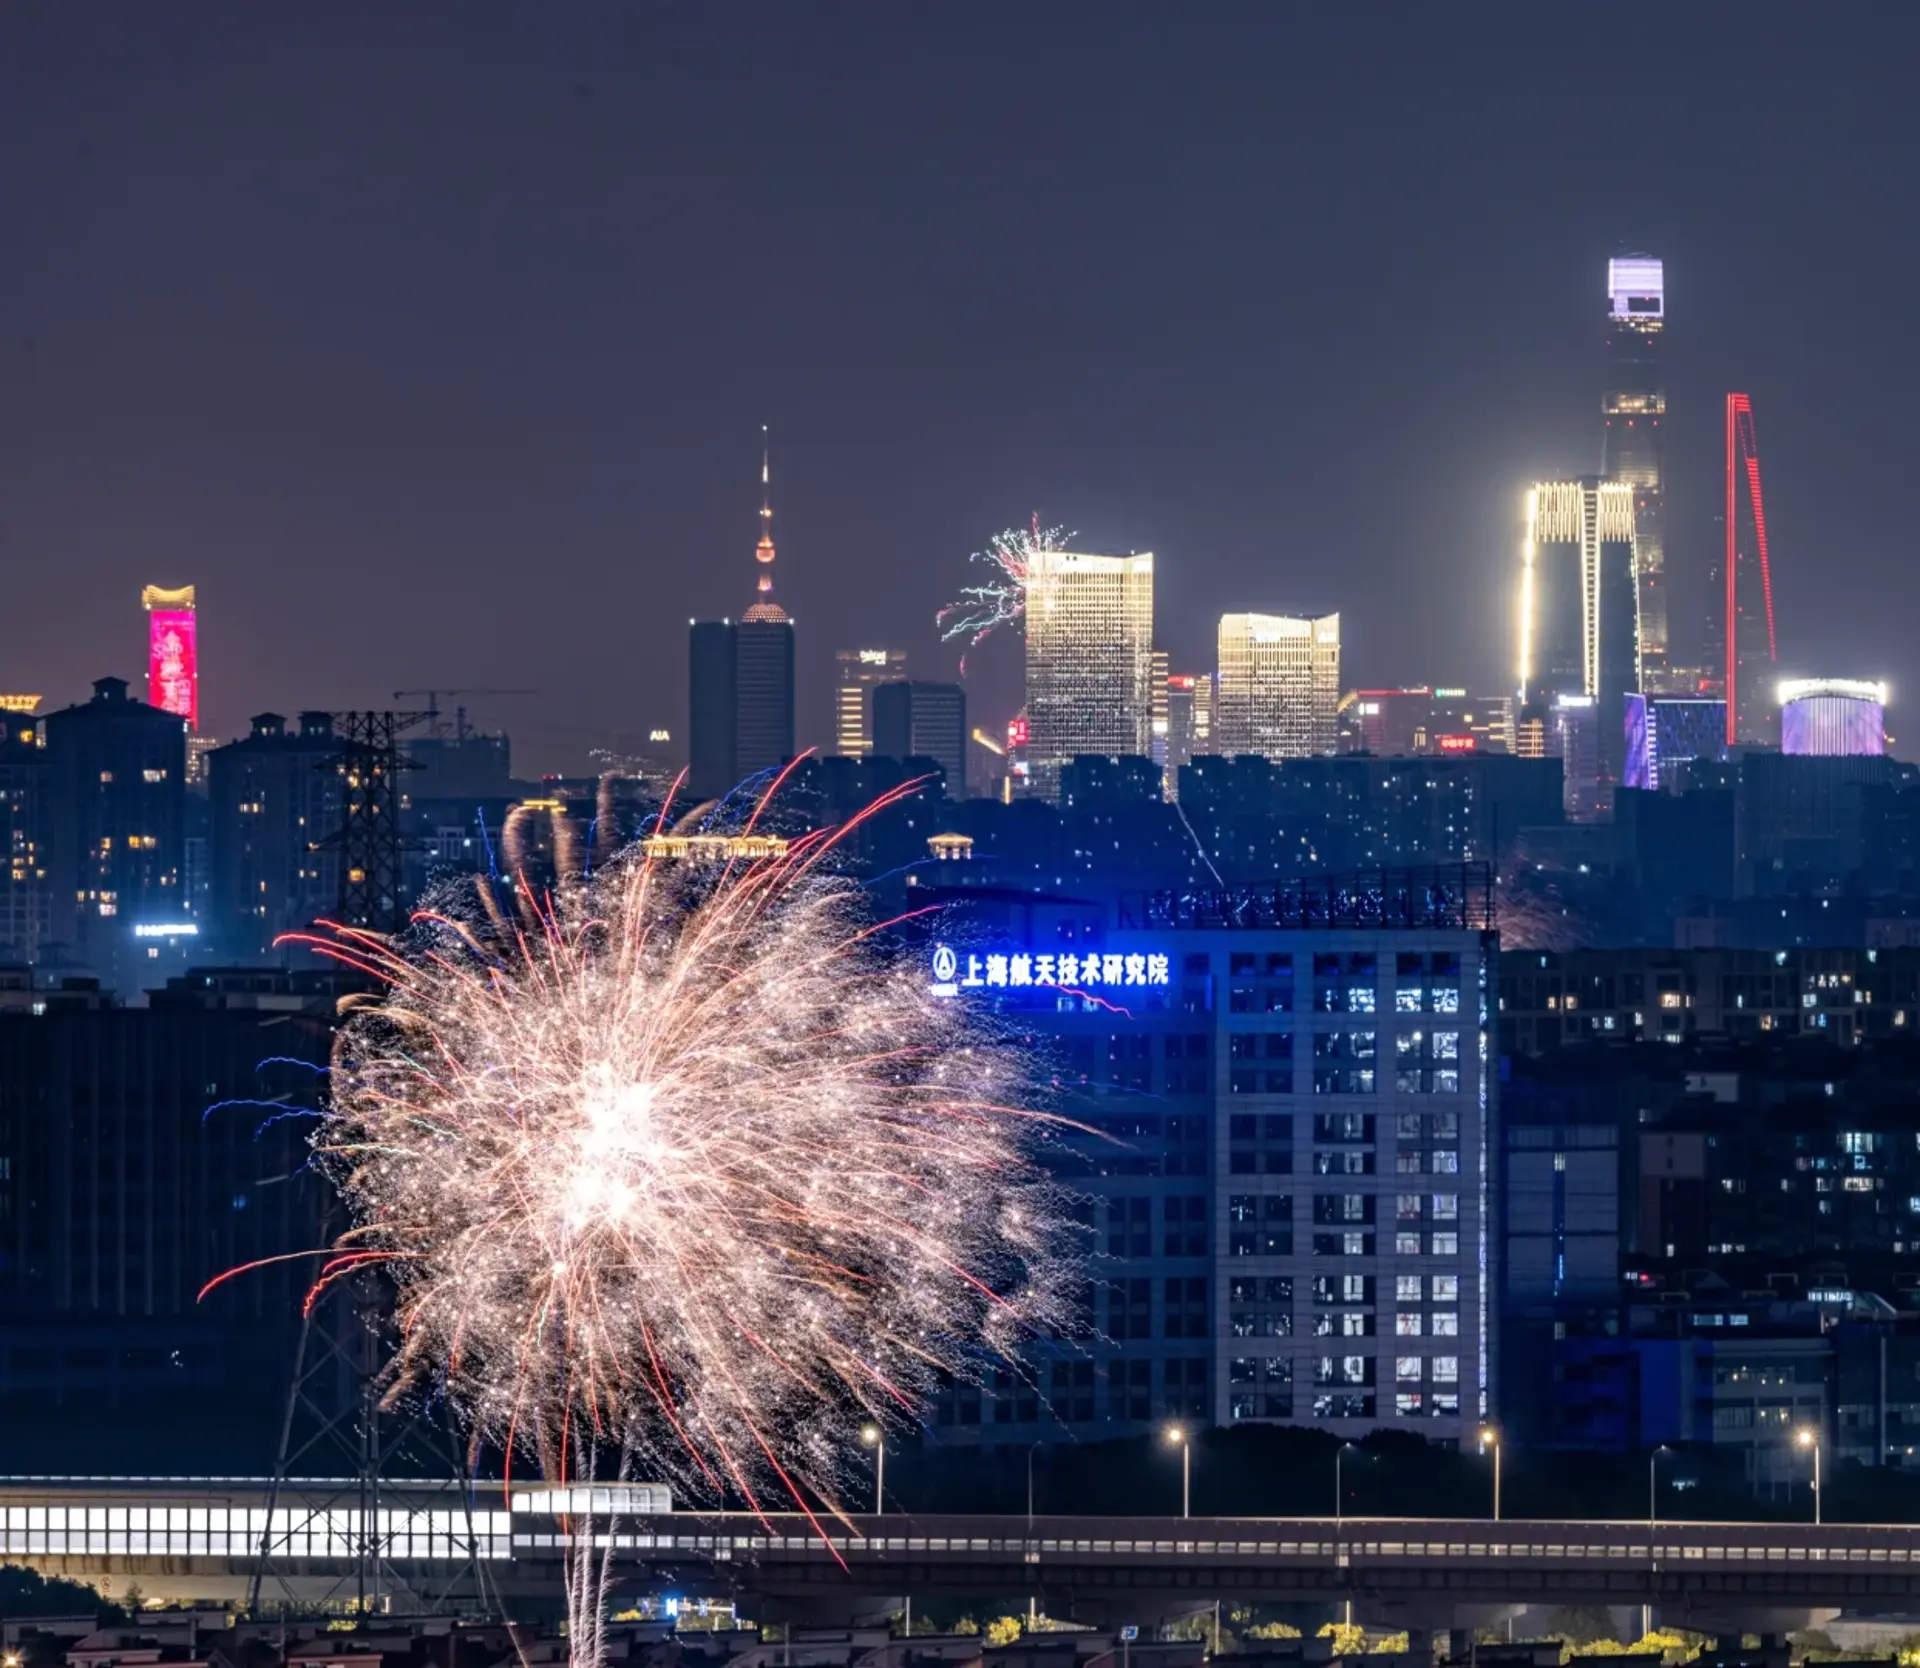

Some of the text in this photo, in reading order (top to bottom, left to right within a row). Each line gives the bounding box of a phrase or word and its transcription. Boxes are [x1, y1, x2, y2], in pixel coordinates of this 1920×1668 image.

[649, 730, 670, 740] AIA
[962, 953, 1169, 987] 上海航天技术研究院
